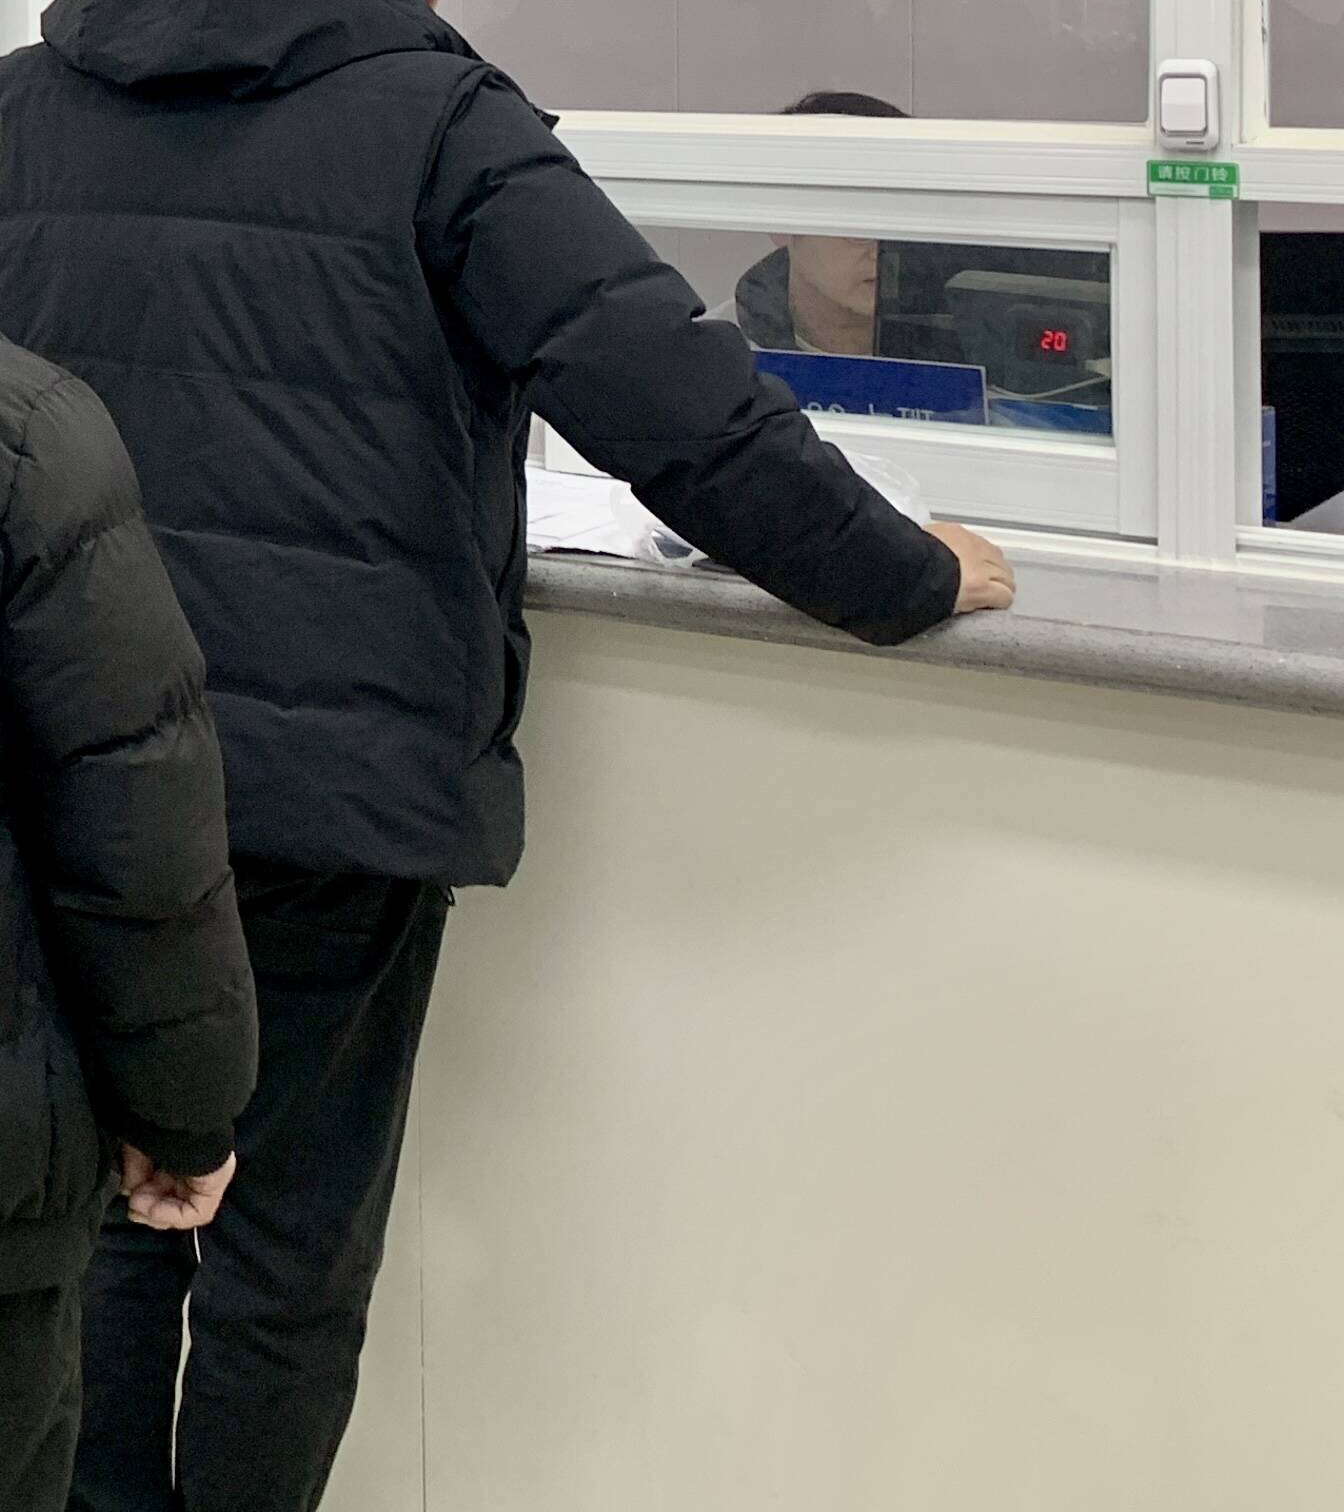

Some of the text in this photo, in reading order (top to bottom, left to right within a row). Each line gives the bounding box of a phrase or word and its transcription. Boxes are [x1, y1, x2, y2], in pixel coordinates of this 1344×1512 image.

[1157, 165, 1229, 182] 请按门铃
[1041, 330, 1067, 352] 20
